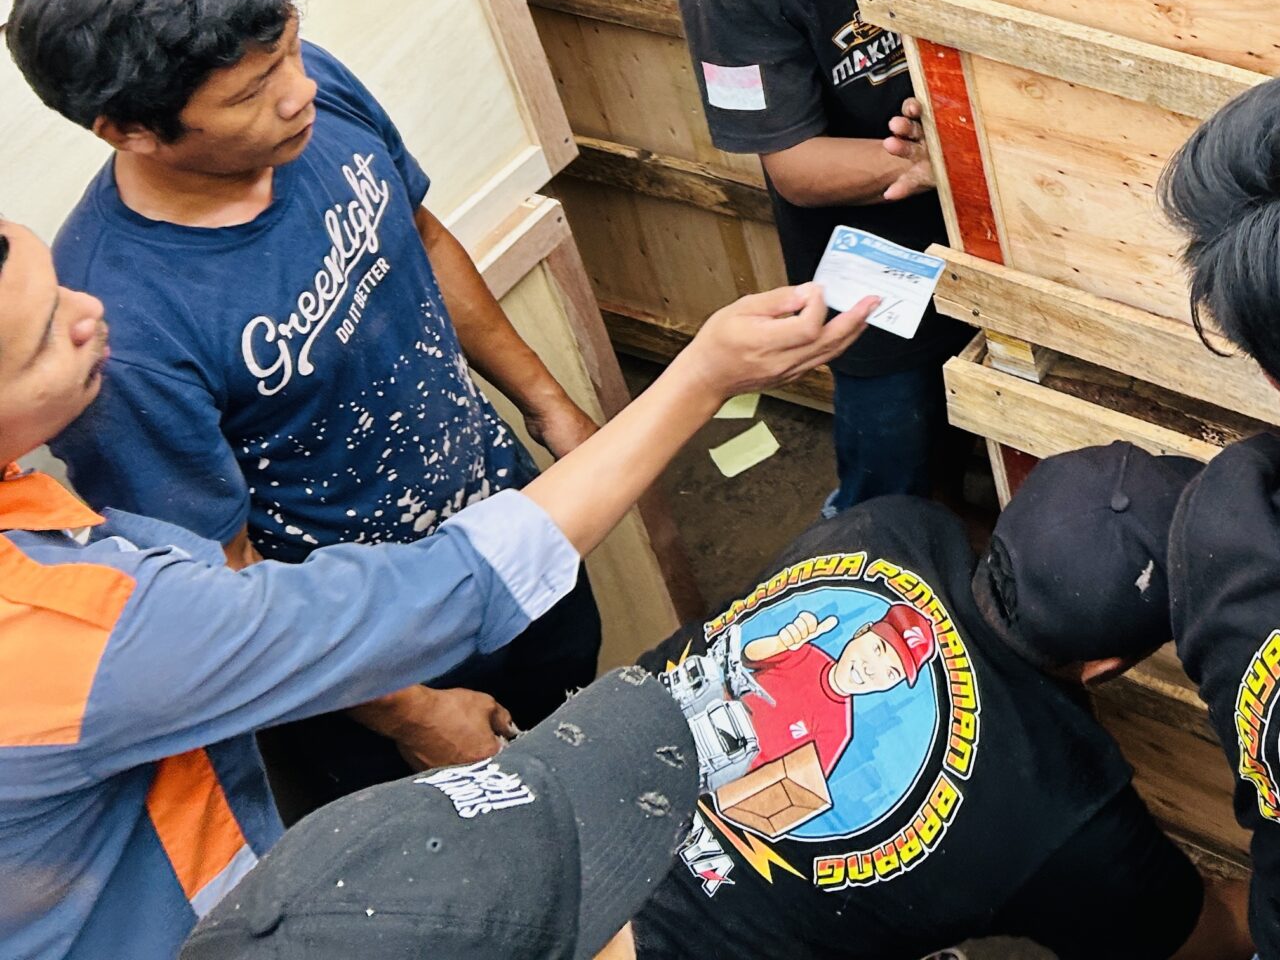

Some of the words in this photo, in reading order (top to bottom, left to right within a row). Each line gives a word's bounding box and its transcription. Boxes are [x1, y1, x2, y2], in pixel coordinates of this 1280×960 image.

[242, 153, 389, 396] Greenlight
[348, 302, 362, 324] IT
[353, 257, 391, 309] BETTER
[335, 318, 354, 344] DO
[865, 558, 981, 780] PENGIRIMAN
[813, 771, 963, 892] BARANG
